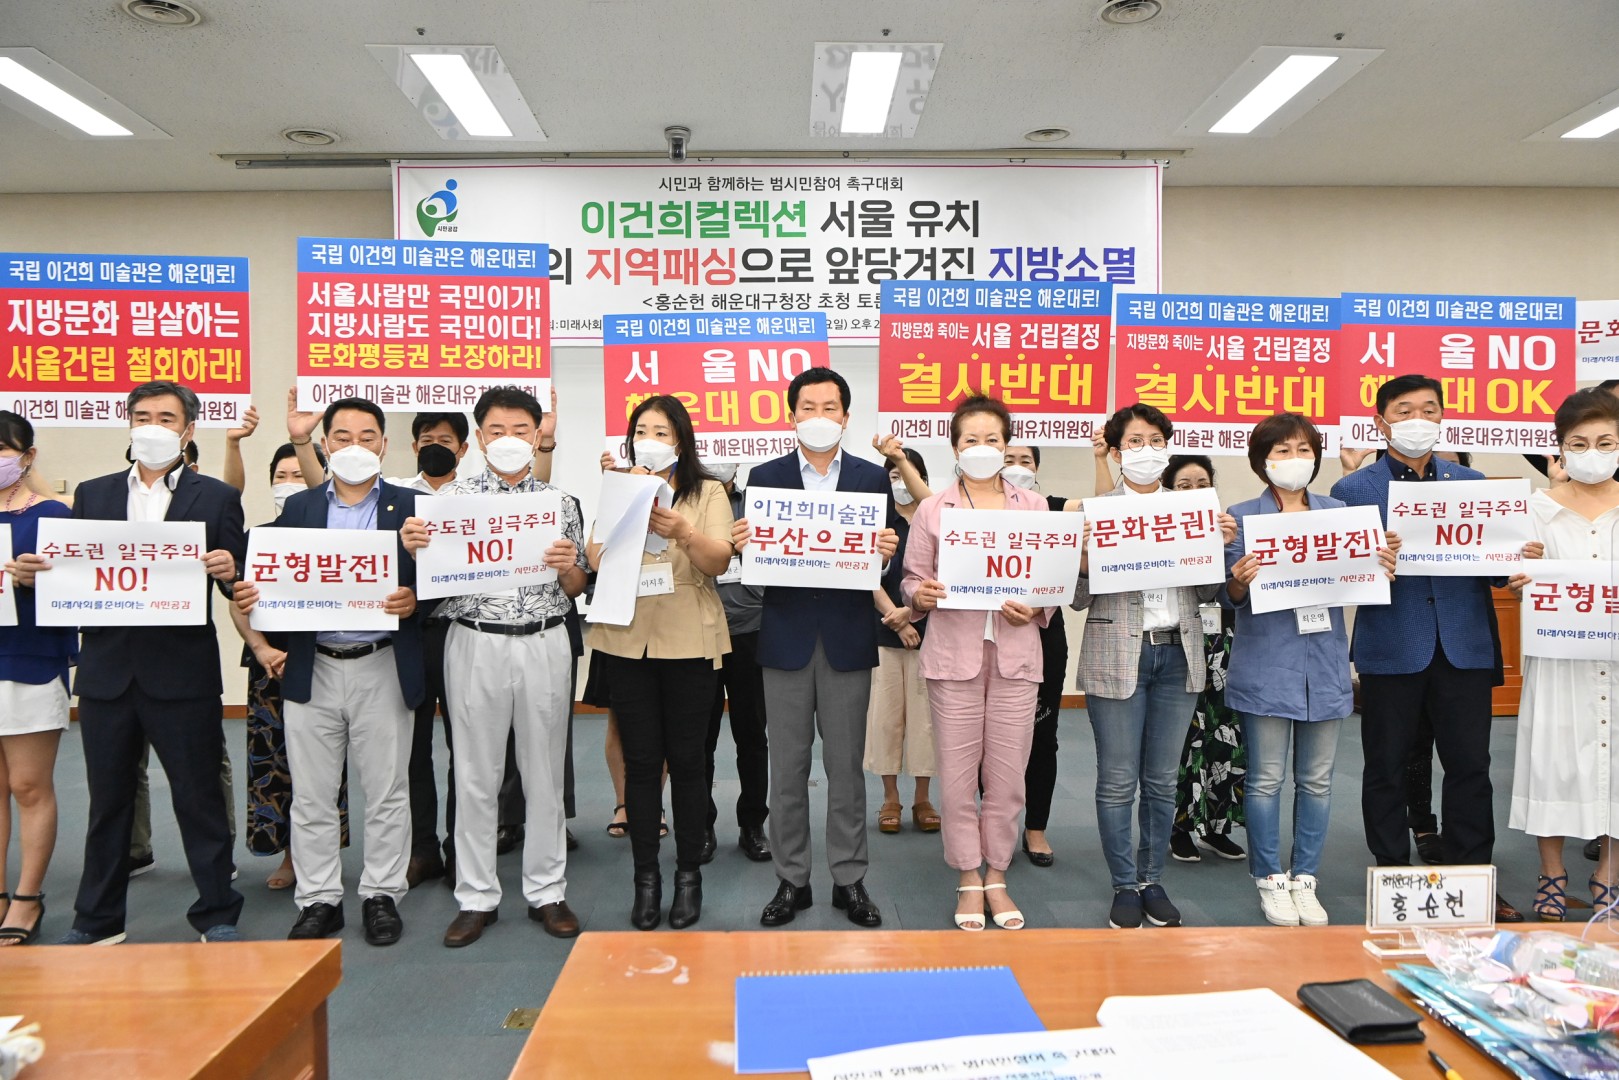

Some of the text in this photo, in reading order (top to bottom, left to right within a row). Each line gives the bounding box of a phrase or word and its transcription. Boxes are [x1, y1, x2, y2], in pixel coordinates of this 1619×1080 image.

[659, 176, 904, 192] 시민과 함께하는 범시민참여 촉구대회
[581, 199, 980, 239] 이건희컬렉션 서울 유치
[311, 244, 536, 269] 국립 이건희 미술관은 해운대로!
[585, 247, 815, 286] 지역패싱으로
[826, 246, 975, 284] 앞당겨진
[988, 246, 1136, 285] 지방소멸
[9, 260, 236, 285] 국립 이건희 미술관은 해운대로!
[307, 282, 541, 311] 서울사람만 국민이가!
[711, 292, 812, 311] 해운대구청장
[818, 292, 850, 310] 초청
[893, 287, 1100, 309] 국립 이건희 미술관은 해운대로!
[1353, 298, 1563, 321] 국립 이건희 미술관은 해운대로!
[7, 299, 240, 338] 지방문화 말살하는
[1128, 300, 1329, 323] 국립 이건희 미술관은 해운대로!
[308, 313, 541, 340] 지방사람도 국민이다!
[615, 317, 816, 337] 국립 이건희 미술관은 해운대로!
[890, 322, 1100, 351] 지방문화 죽이는 서울 건립결정
[308, 343, 542, 370] 문화평등권 보장하라!
[1127, 333, 1331, 363] 지방문화 죽이는 서울 건립결정
[1488, 334, 1557, 371] NO
[7, 346, 242, 384] 서울건립 철회하라!
[748, 348, 812, 383] NO
[312, 384, 358, 405] 이건희
[365, 384, 411, 405] 미술관
[898, 361, 1093, 406] 결사반대
[1134, 372, 1325, 417] 결사반대
[1486, 378, 1556, 415] OK
[13, 399, 58, 420] 이건희
[65, 400, 110, 421] 미술관
[891, 419, 932, 439] 이건희
[1173, 429, 1214, 448] 미술관
[753, 499, 880, 527] 이건희미술관
[1392, 499, 1528, 519] 수도권 일극주의
[424, 511, 557, 536] 수도권 일극주의
[1093, 508, 1216, 548] 문화분권!
[1435, 523, 1484, 546] NO!
[41, 542, 200, 562] 수도권 일극주의
[467, 538, 514, 564] NO!
[750, 526, 878, 556] 부산으로!
[944, 530, 1078, 550] 수도권 일극주의
[1252, 528, 1382, 567] 균형발전!
[94, 566, 149, 592] NO!
[251, 552, 390, 583] 균형발전!
[986, 555, 1032, 579] NO!
